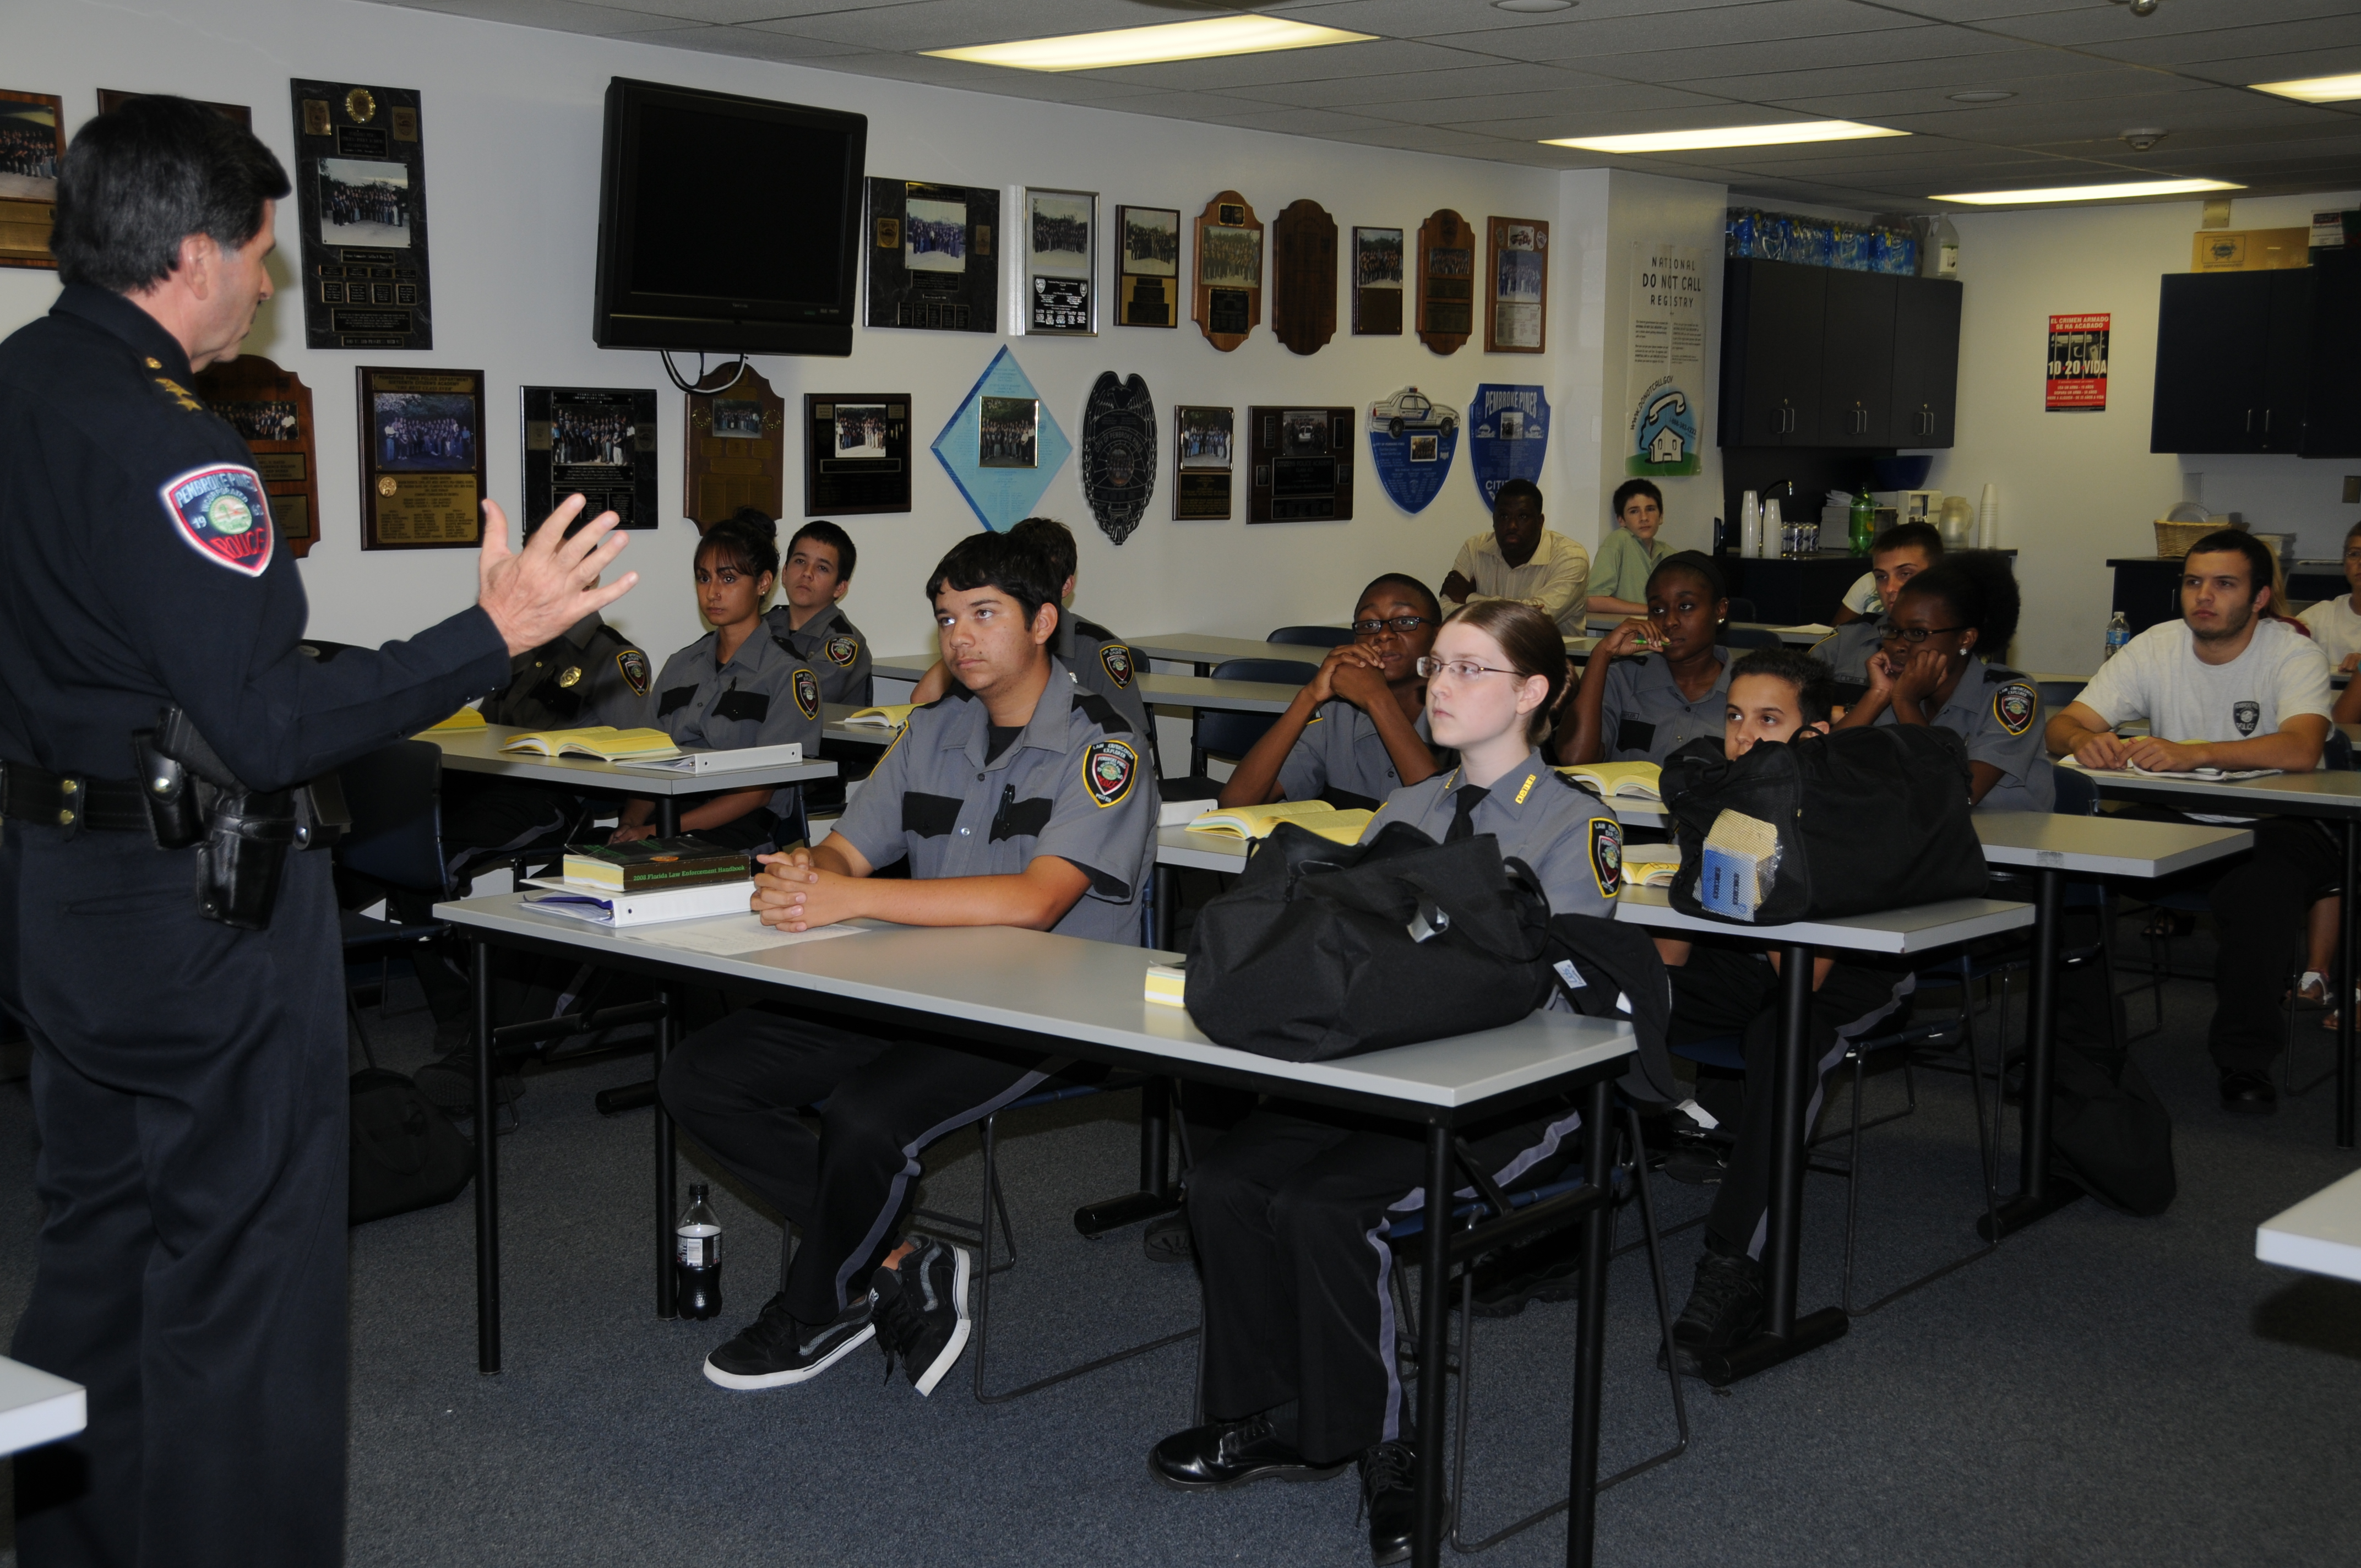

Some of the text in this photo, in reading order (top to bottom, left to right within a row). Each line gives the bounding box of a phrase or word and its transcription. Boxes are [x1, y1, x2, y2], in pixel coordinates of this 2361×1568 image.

[1652, 257, 1695, 271] NATIONAL
[1642, 273, 1701, 291] DO NOT CALL
[1651, 295, 1694, 308] REGISTRY
[2048, 360, 2107, 375] 10 20 VIDA
[1484, 391, 1537, 419] PEMBROKE PINES
[1095, 431, 1143, 453] CITY OF PEMBROKE PINES
[175, 472, 258, 509] PEMBROKE PINES
[201, 488, 248, 513] INCORPORATED
[192, 515, 207, 529] 19
[209, 527, 265, 559] POLICE
[1103, 748, 1126, 759] EXPLORER
[1108, 743, 1134, 760] ENFORCEMENT
[682, 868, 717, 876] Enforcement
